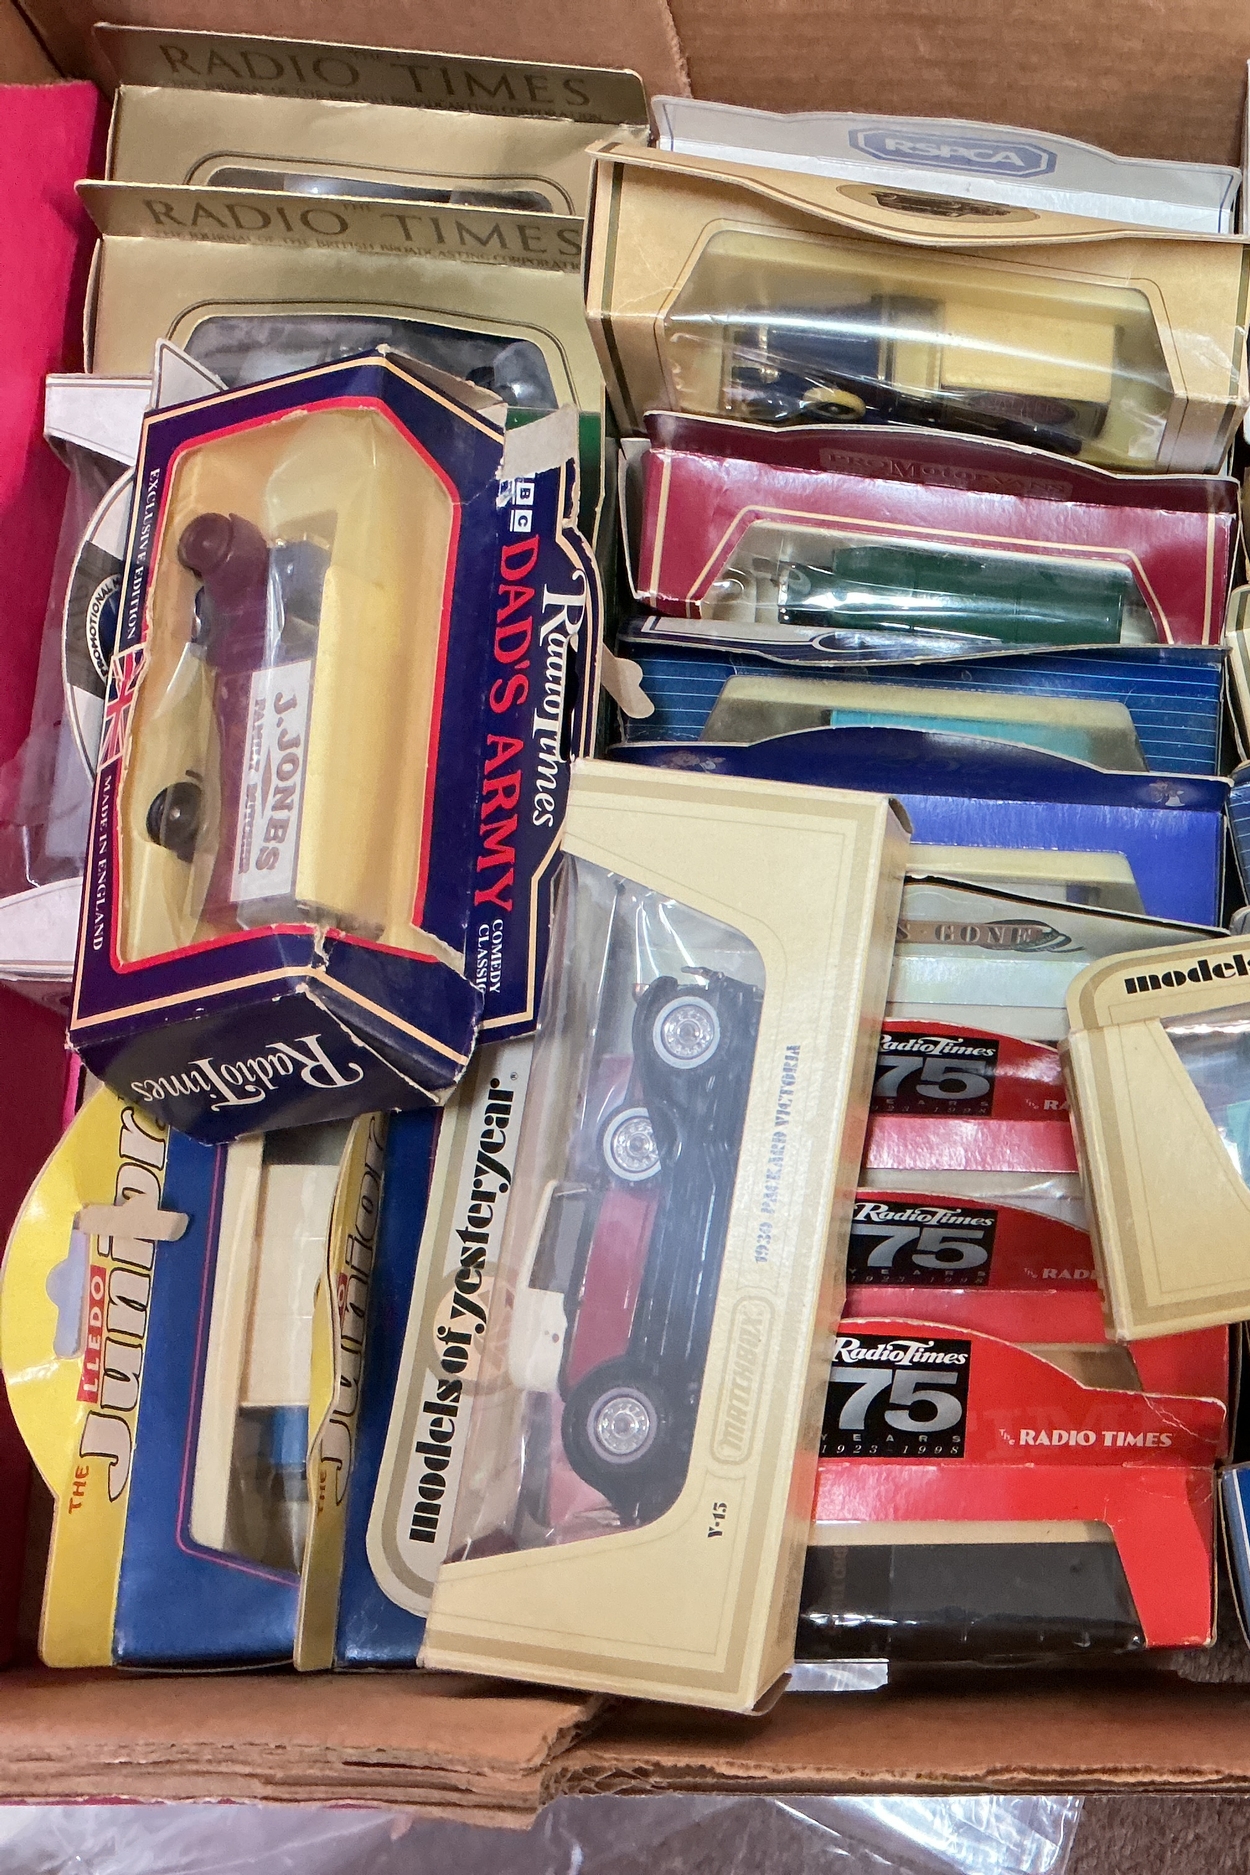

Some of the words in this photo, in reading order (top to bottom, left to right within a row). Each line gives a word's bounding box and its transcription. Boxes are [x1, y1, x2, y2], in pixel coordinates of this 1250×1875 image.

[158, 44, 360, 87] RADIO
[390, 63, 591, 107] TIMES
[885, 137, 1026, 167] RSPCA
[143, 199, 349, 236] RADIO
[380, 214, 581, 256] TIMES
[136, 467, 160, 563] EXCLUSIVE
[127, 564, 143, 641] EDITION
[489, 534, 541, 714] DAD'S
[100, 775, 113, 828] MADE
[474, 735, 524, 912] ARMY
[98, 834, 108, 851] IN
[93, 855, 107, 952] ENGLAND
[934, 924, 1033, 944] GONE
[476, 924, 490, 993] CLASSIC
[489, 919, 504, 993] COMEDY
[131, 1033, 364, 1111] RadioTimes
[774, 1044, 801, 1127] VICTORIA
[875, 1055, 991, 1100] 75
[761, 1131, 787, 1215] PACKARD
[450, 1077, 514, 1335] yesteryear
[853, 1202, 995, 1227] RadioTimes
[754, 1221, 773, 1264] 1930
[852, 1223, 988, 1270] 75
[81, 1277, 104, 1396] LLEDO
[436, 1326, 472, 1374] of
[832, 1336, 969, 1366] RadioTimes
[719, 1308, 766, 1455] MATCHBOX
[829, 1366, 963, 1433] 75
[409, 1379, 463, 1542] models
[820, 1434, 961, 1443] YEARS
[999, 1428, 1015, 1446] The
[1019, 1429, 1096, 1446] RADIO
[1101, 1430, 1173, 1447] TIMES
[68, 1464, 89, 1514] THE
[708, 1502, 729, 1539] Y-15
